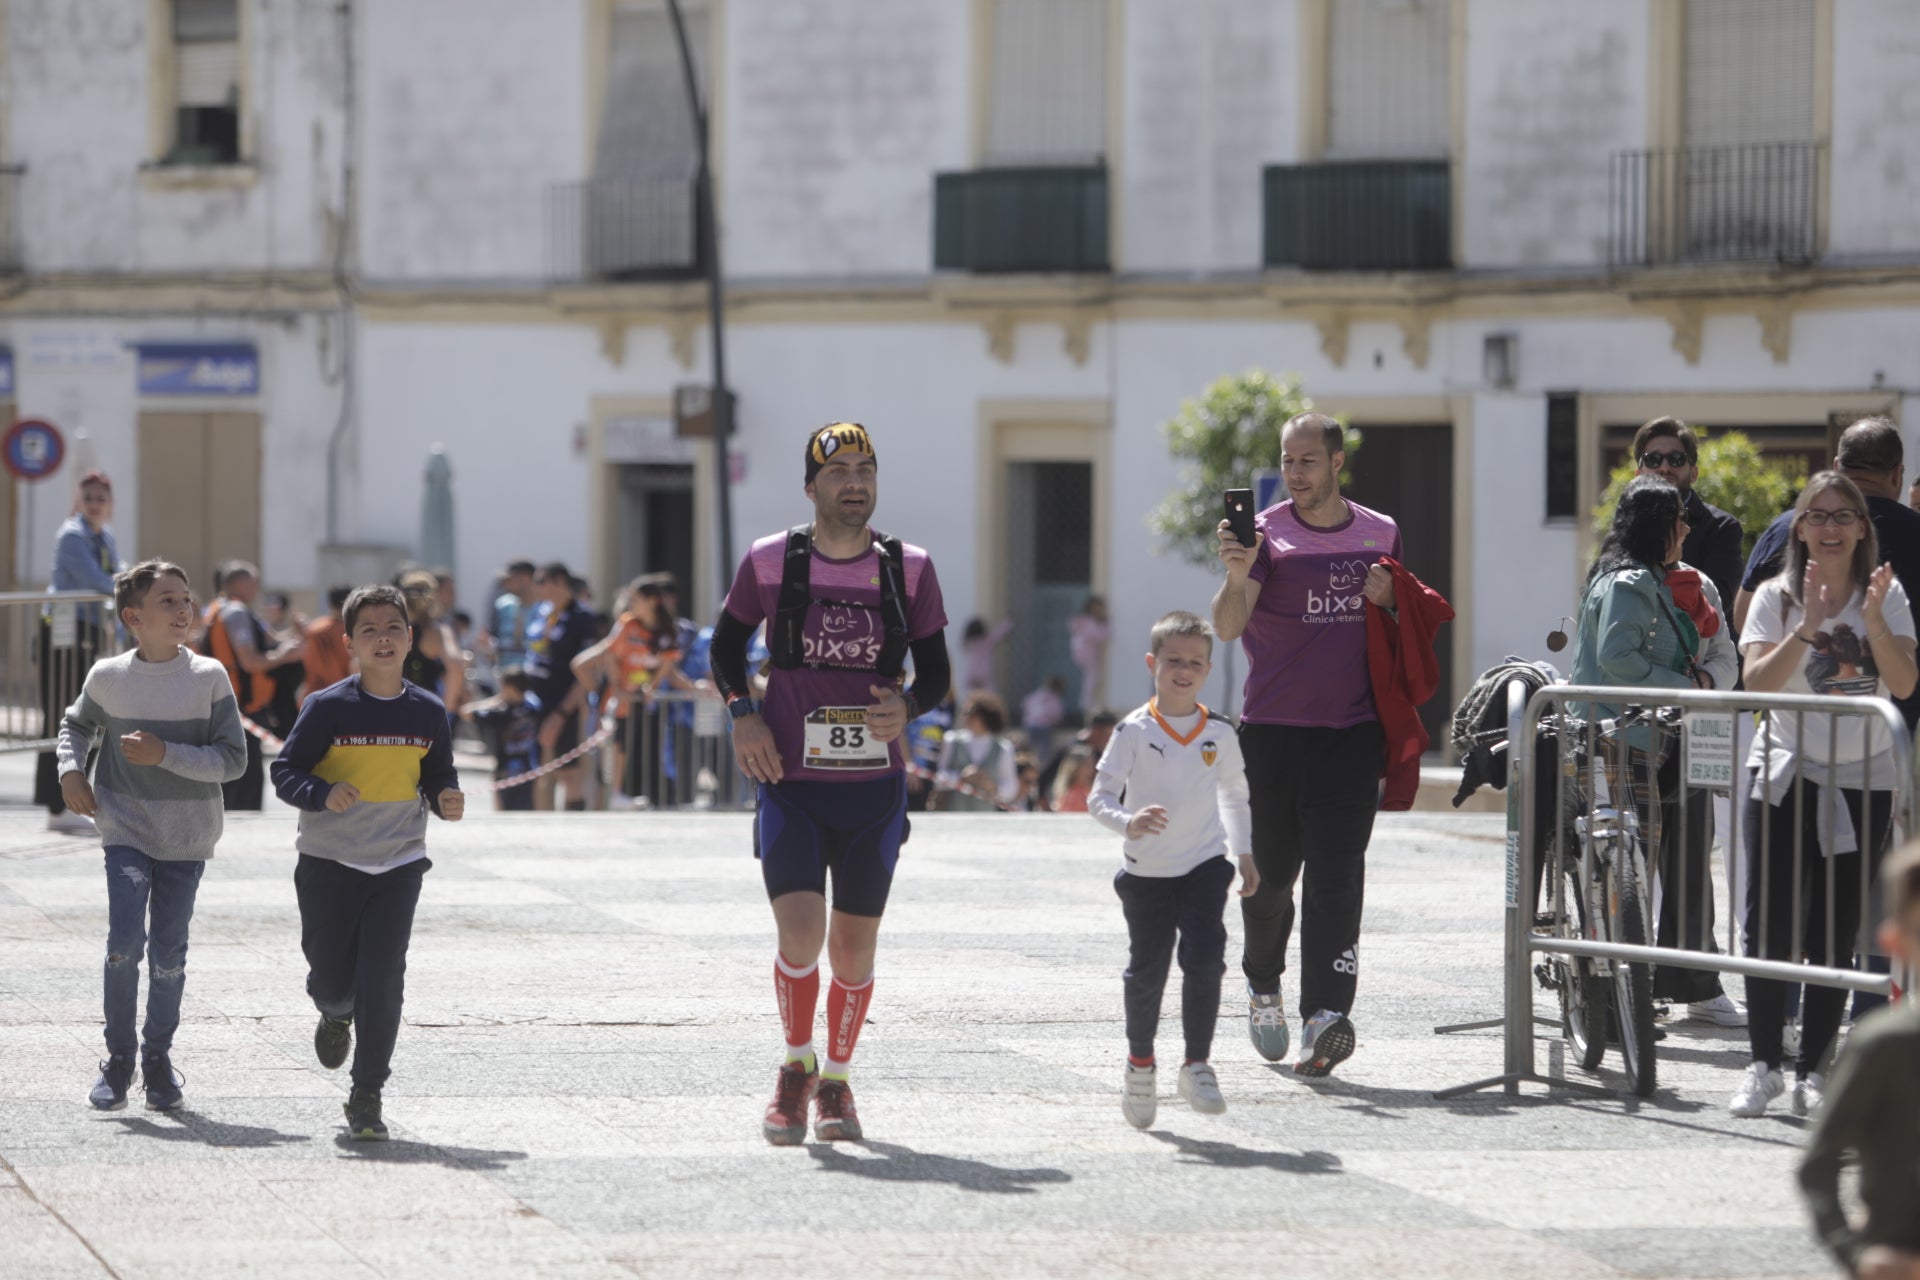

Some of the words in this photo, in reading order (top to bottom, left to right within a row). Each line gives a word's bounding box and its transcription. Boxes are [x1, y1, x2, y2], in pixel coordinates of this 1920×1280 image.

[1307, 589, 1364, 614] bixo
[350, 737, 367, 746] 1965
[376, 736, 406, 746] BENETTON
[829, 726, 864, 748] 83
[1506, 836, 1515, 904] ALQUIVALLE
